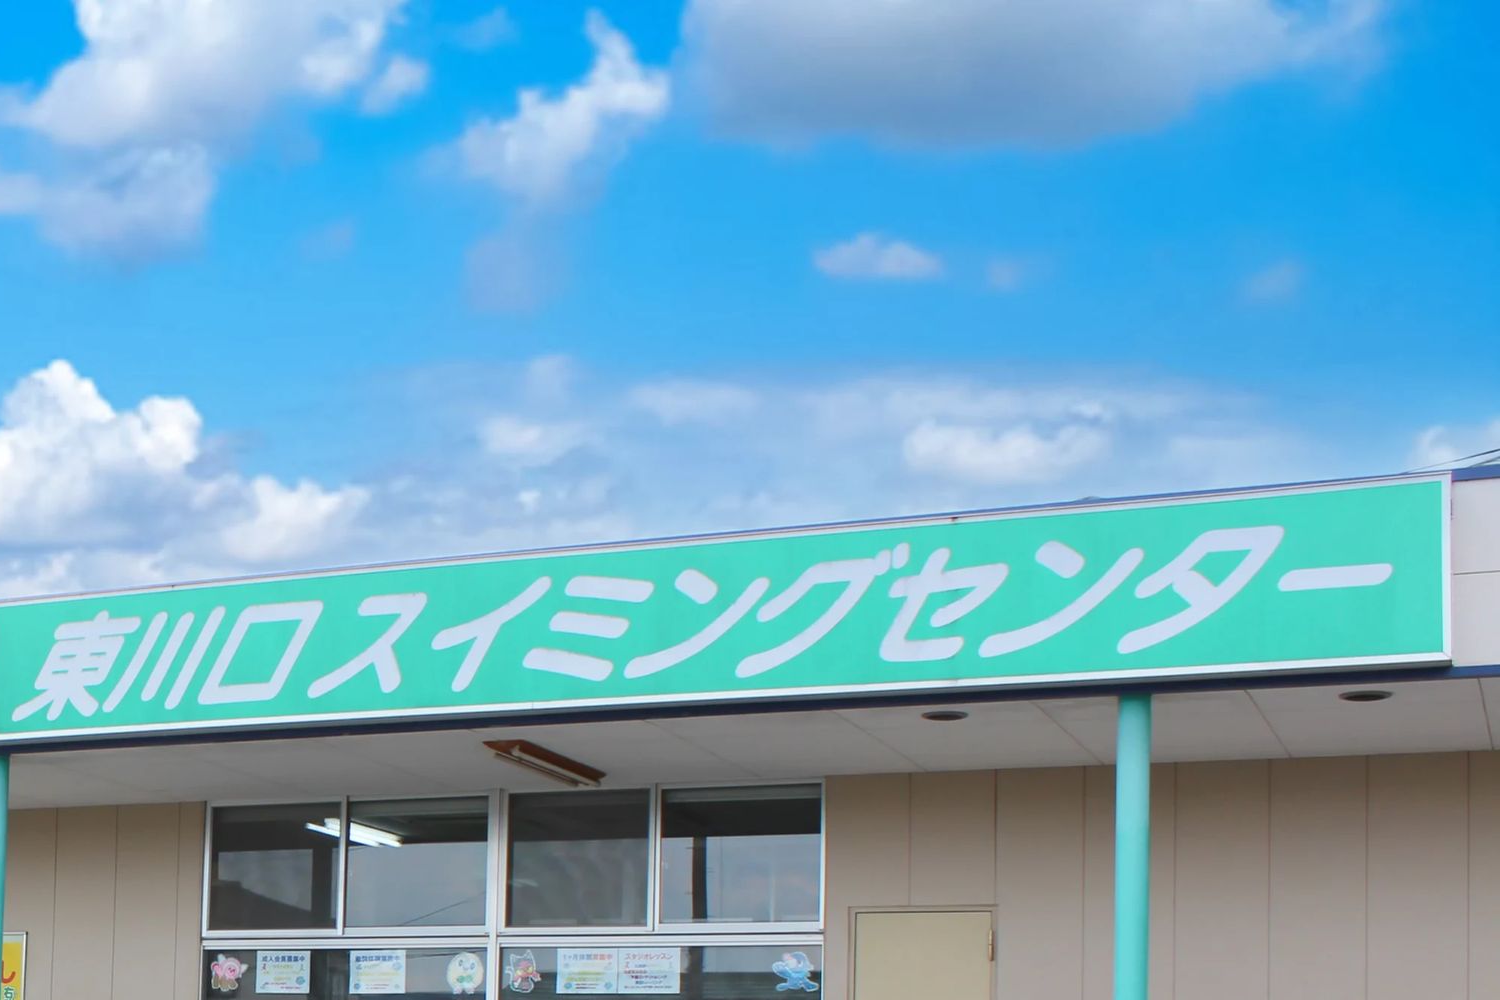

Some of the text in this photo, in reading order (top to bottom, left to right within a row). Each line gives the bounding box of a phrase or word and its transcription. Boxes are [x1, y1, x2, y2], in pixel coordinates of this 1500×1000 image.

[11, 524, 1394, 722] 東川口スイミングセンター
